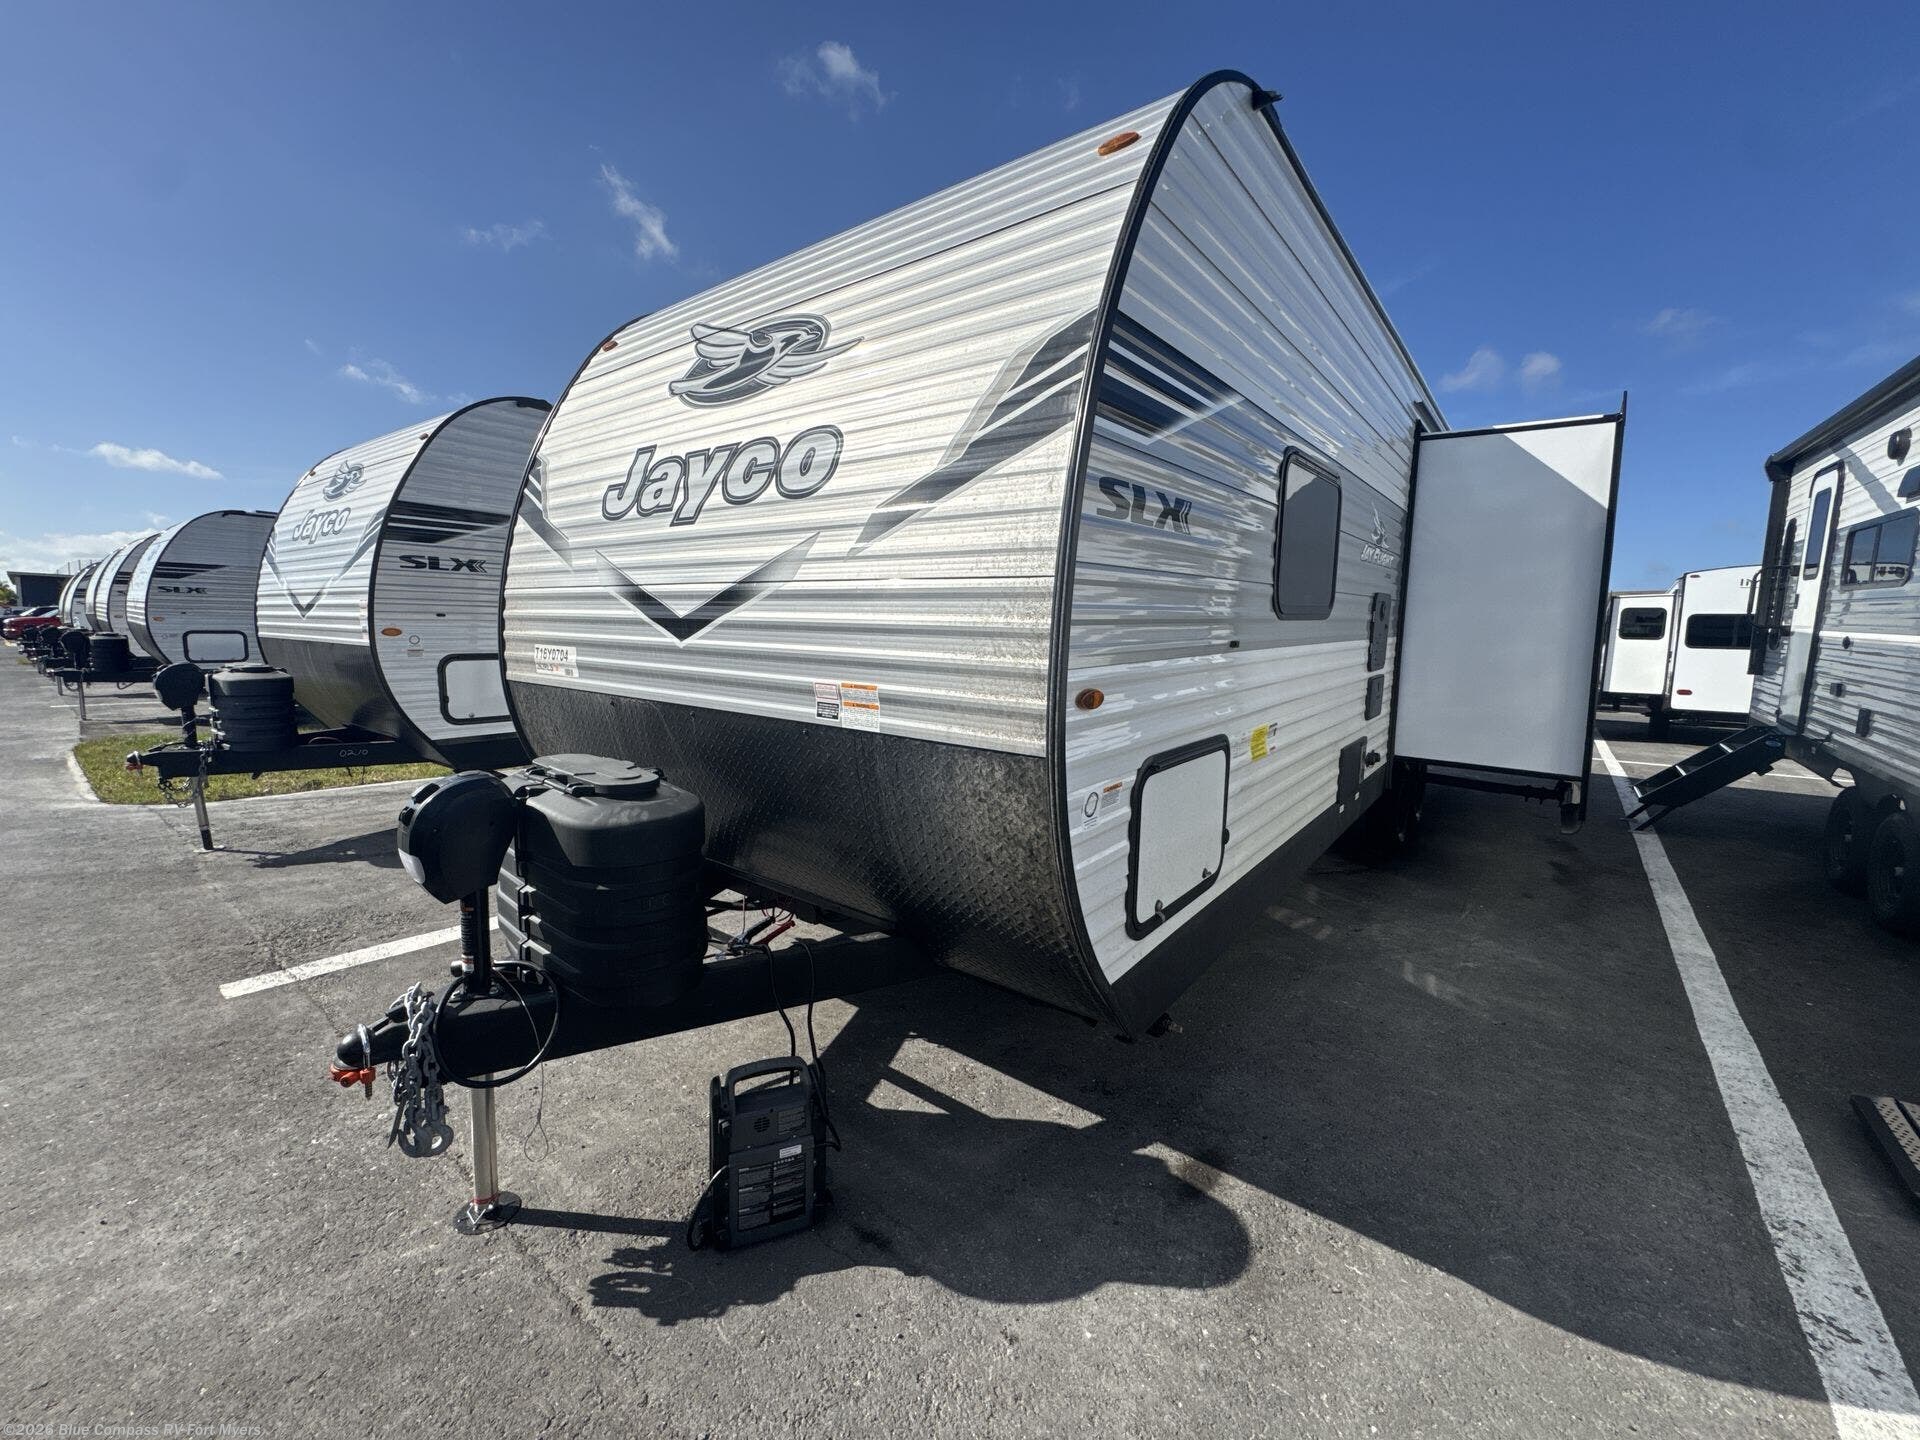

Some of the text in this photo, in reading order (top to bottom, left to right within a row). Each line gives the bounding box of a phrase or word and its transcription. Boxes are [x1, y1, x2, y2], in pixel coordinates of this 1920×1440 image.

[602, 425, 844, 527] Jayco
[293, 507, 351, 544] Jayco
[1096, 477, 1192, 536] SLX
[399, 555, 488, 573] SLX
